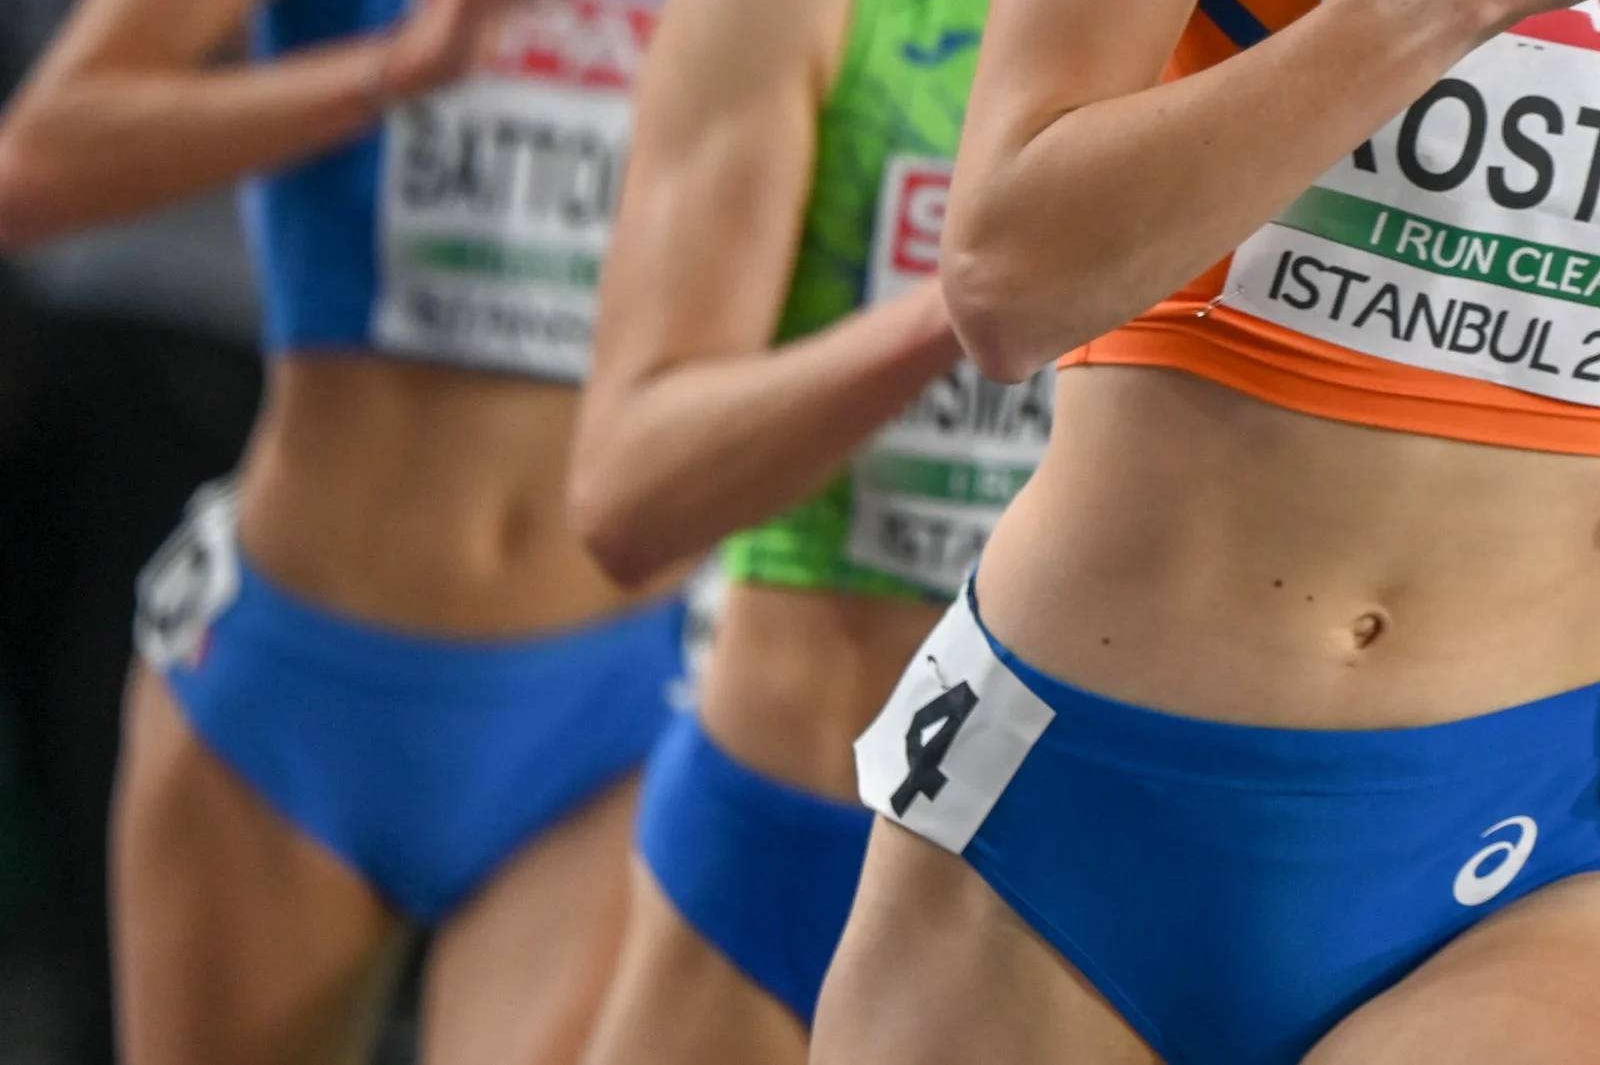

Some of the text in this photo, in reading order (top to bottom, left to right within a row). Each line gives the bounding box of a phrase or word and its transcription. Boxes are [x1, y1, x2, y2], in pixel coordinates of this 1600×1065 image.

[1369, 211, 1388, 245] I
[1396, 220, 1499, 275] RUN
[1268, 250, 1560, 375] ISTANBUL
[890, 679, 981, 819] 4
